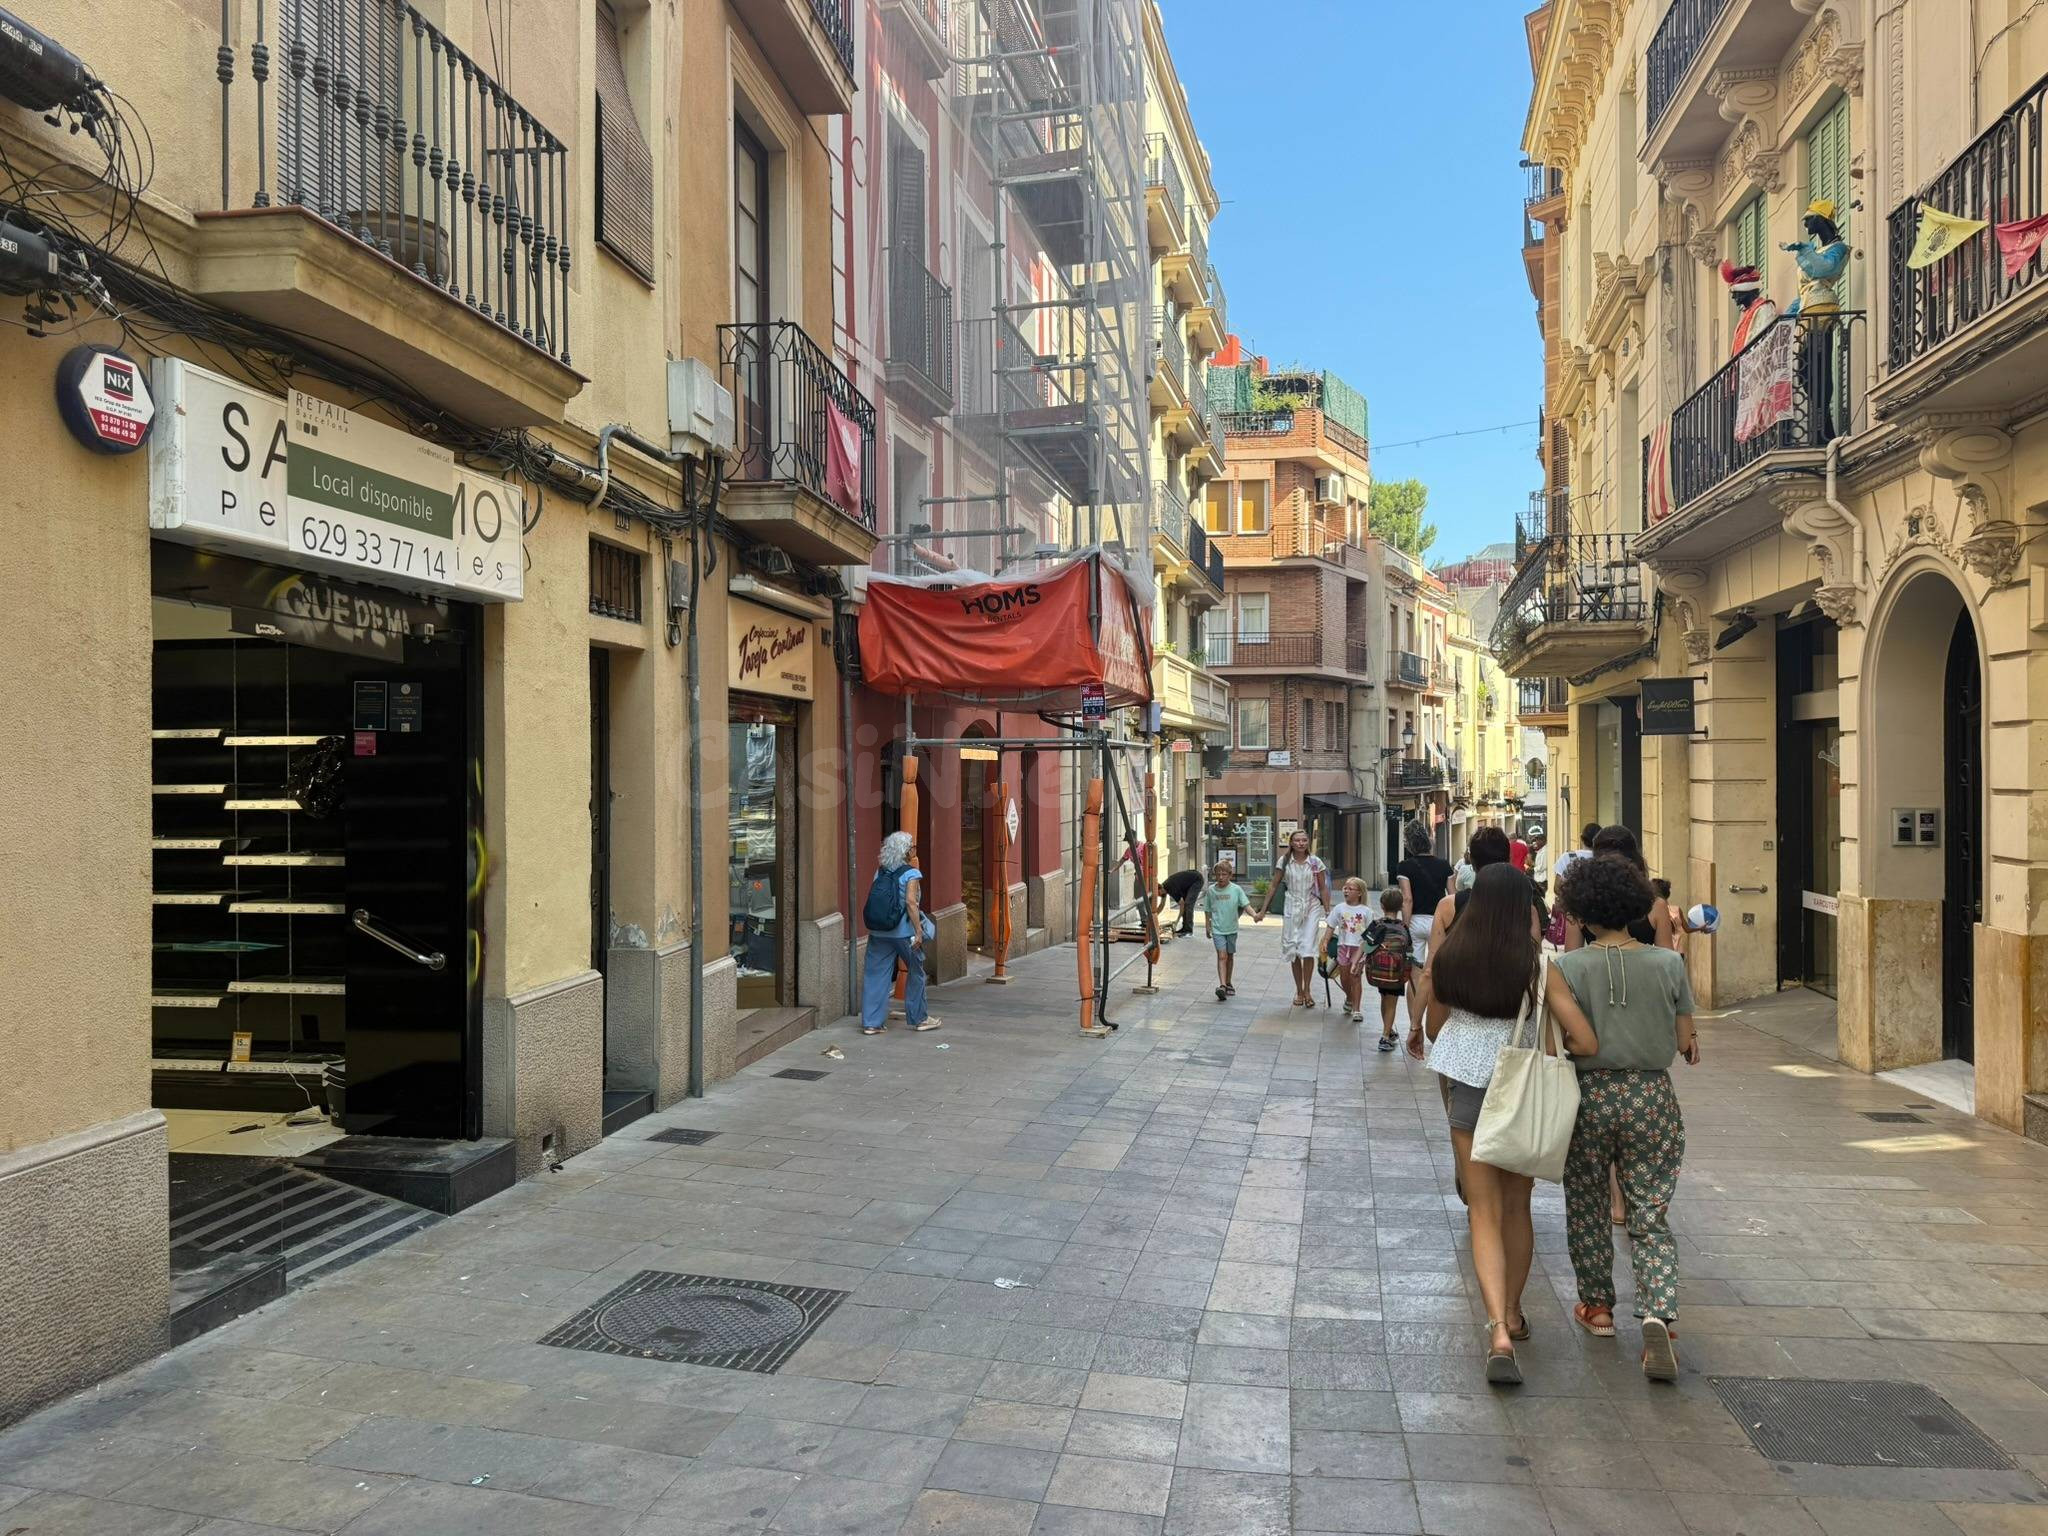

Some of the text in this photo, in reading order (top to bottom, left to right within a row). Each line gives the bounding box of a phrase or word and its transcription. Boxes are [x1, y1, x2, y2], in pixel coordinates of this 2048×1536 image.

[107, 371, 131, 391] NiX
[296, 392, 349, 425] RETAIL
[296, 407, 349, 433] Barcelona
[313, 465, 433, 522] Local disponible
[302, 517, 446, 580] 629 33 77 14
[961, 584, 1041, 615] HOMS
[987, 612, 1022, 624] RENTALS
